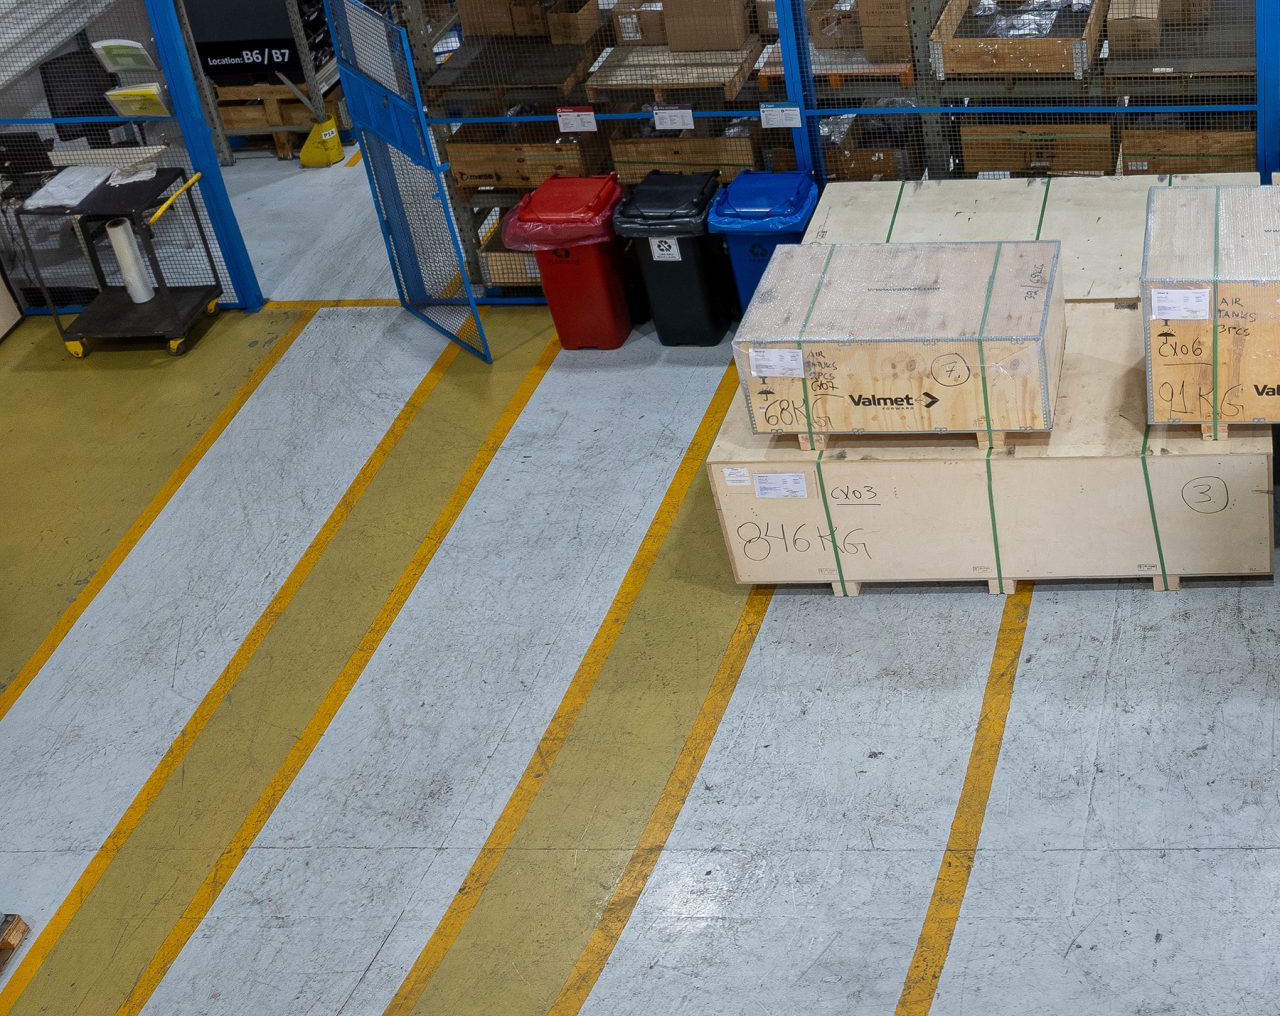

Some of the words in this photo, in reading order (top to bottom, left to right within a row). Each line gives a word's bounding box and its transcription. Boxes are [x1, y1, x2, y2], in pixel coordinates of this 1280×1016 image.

[208, 55, 243, 66] Location:
[243, 50, 261, 64] B6
[272, 49, 289, 63] B7
[1220, 297, 1244, 307] AIR
[848, 395, 914, 407] Valmet
